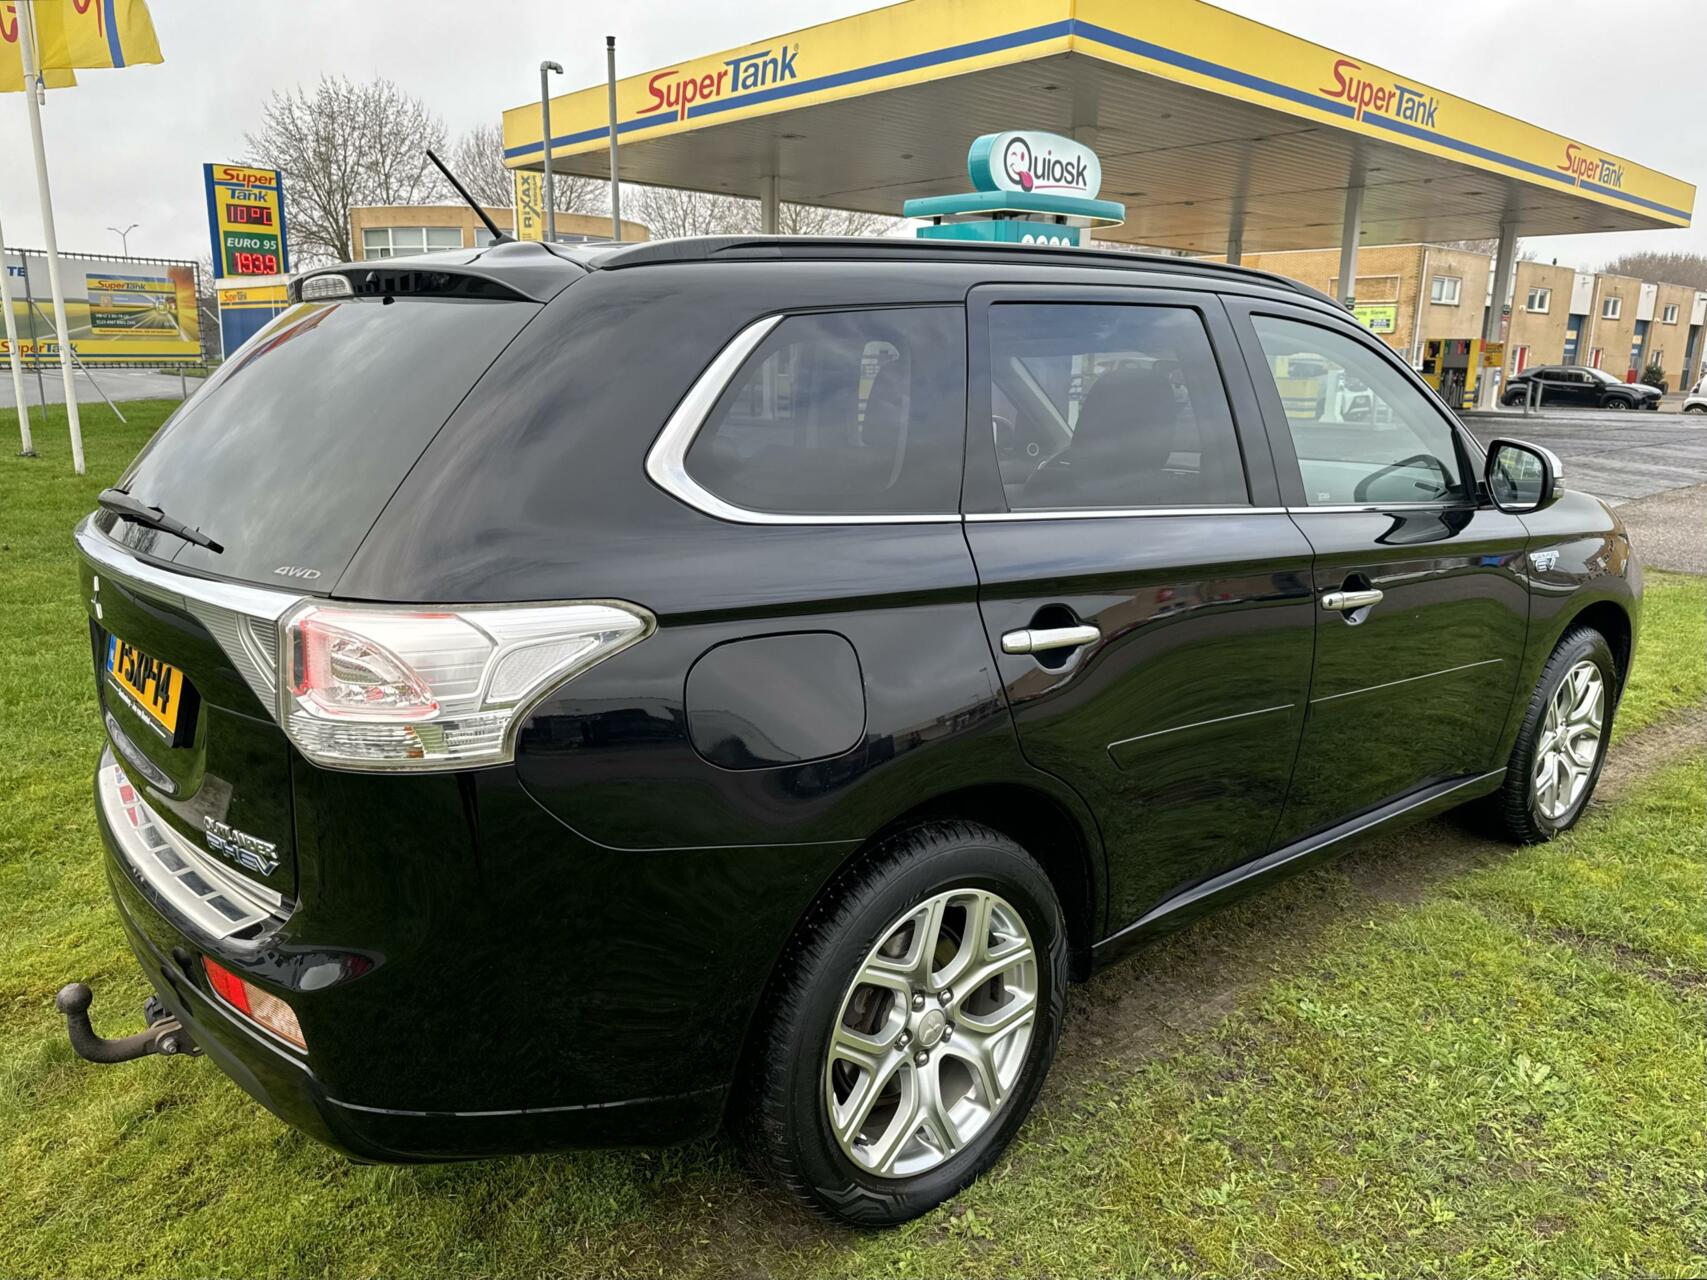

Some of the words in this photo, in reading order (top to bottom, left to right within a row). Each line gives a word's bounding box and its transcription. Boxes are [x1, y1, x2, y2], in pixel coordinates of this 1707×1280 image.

[636, 46, 798, 121] SuperTank
[1318, 59, 1438, 128] SuperTank
[216, 168, 275, 188] Super
[1004, 136, 1088, 192] Quiosk
[1556, 143, 1624, 188] SuperTank
[225, 187, 270, 203] Tank
[227, 238, 260, 249] EURO
[263, 240, 277, 250] 95
[273, 566, 321, 579] 4WD
[203, 815, 278, 859] OUTLANDER
[205, 830, 281, 877] PHEV
